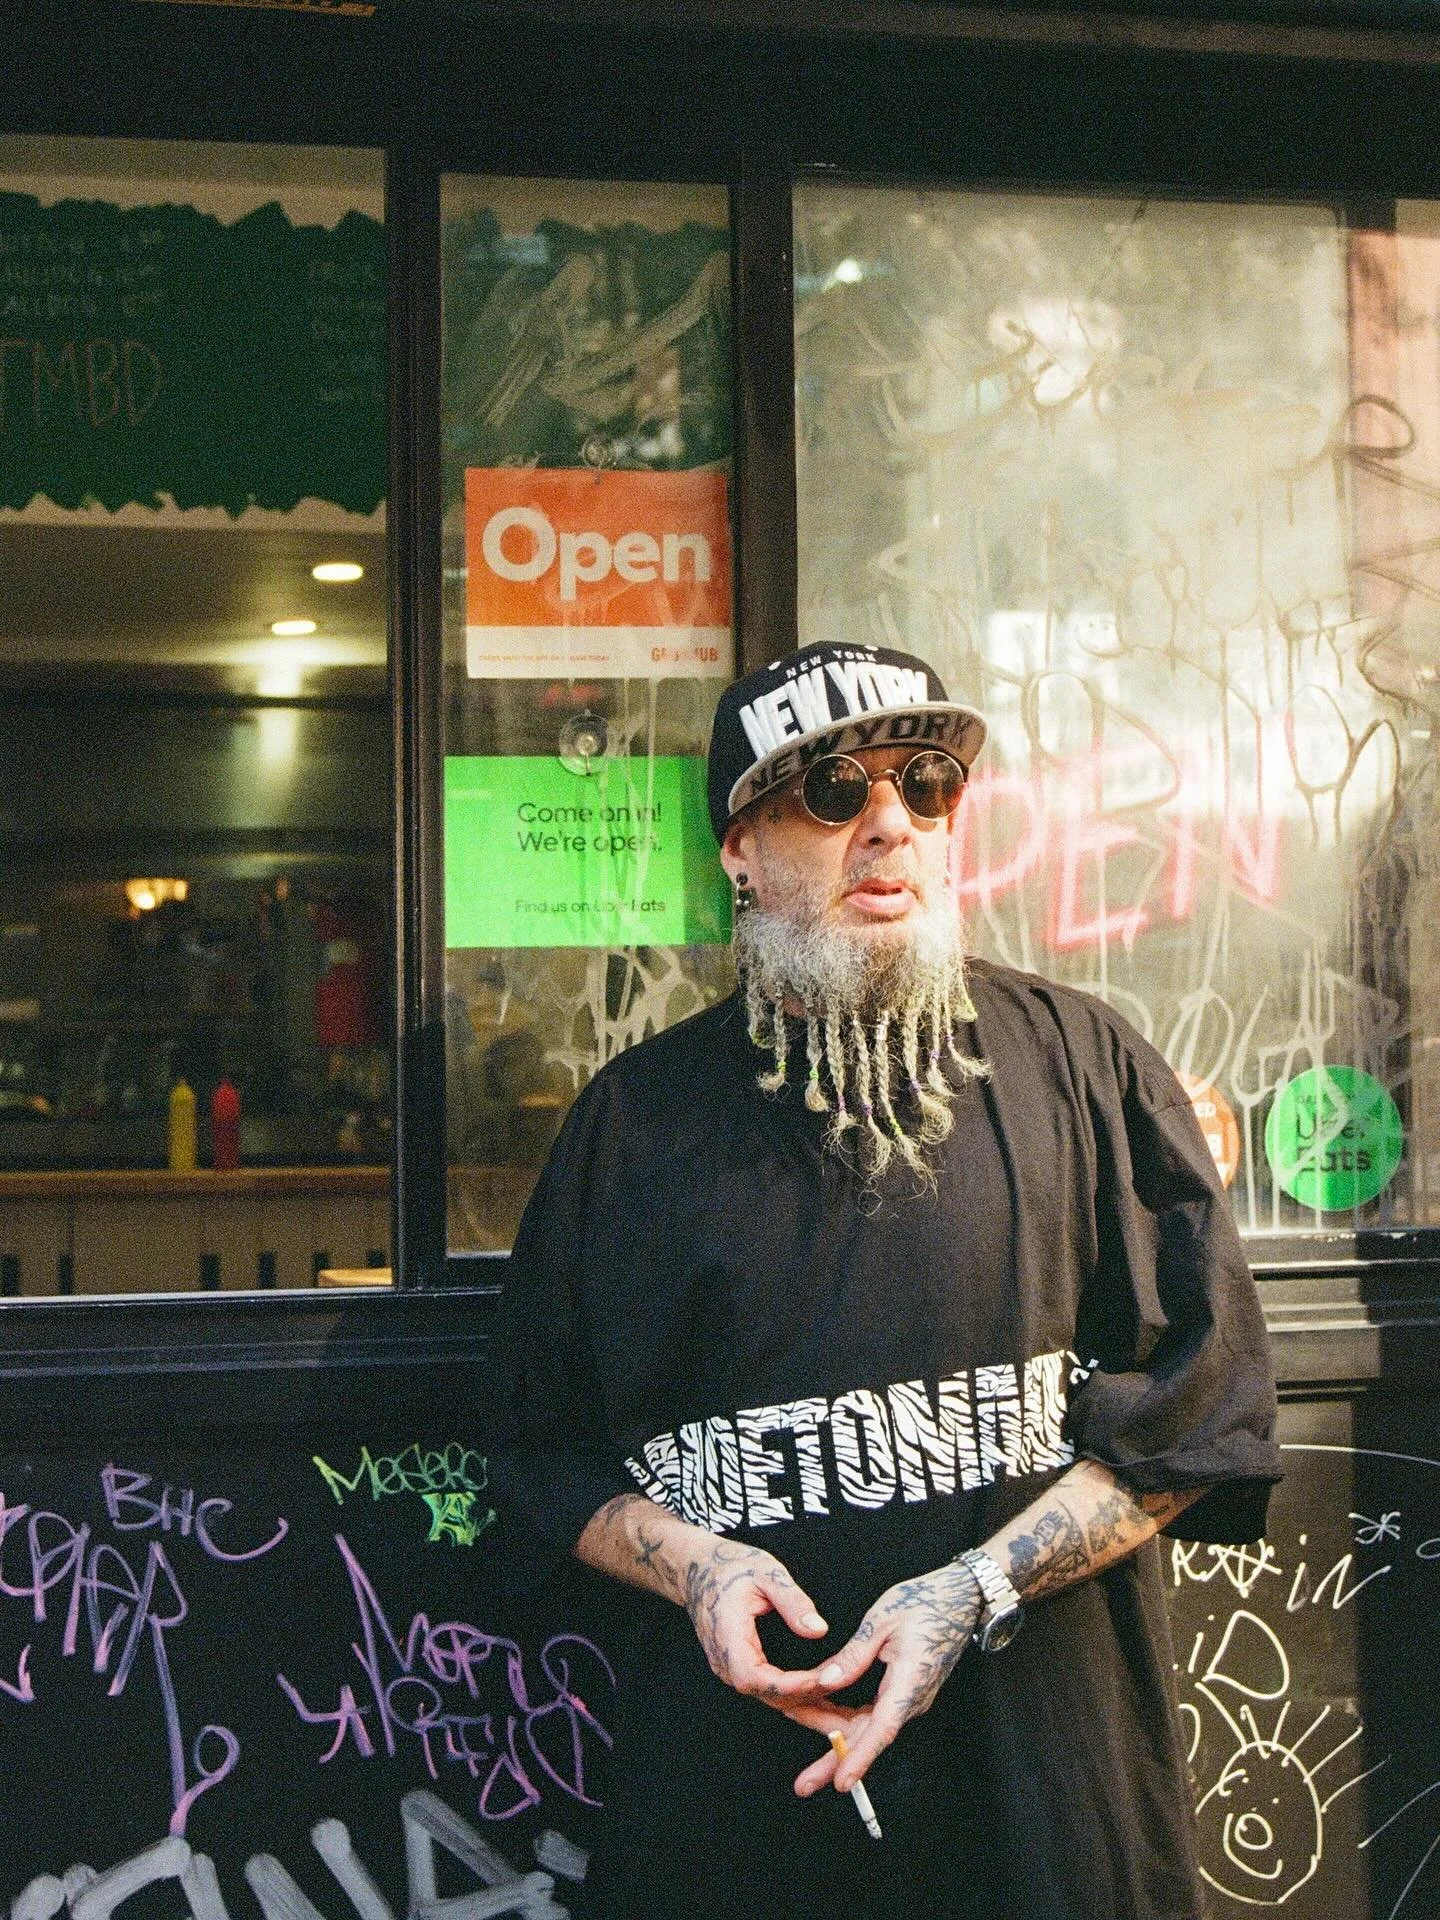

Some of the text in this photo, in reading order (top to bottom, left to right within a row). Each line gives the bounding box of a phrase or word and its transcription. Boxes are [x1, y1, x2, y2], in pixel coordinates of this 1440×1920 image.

[482, 505, 712, 601] Open
[786, 650, 877, 679] NEW YORK
[739, 661, 928, 760] NEW YORK
[852, 714, 974, 749] YORK
[518, 802, 593, 823] Come
[599, 806, 630, 822] on
[517, 830, 586, 852] We're
[515, 899, 548, 913] Find
[551, 902, 568, 913] us
[571, 902, 591, 913] on
